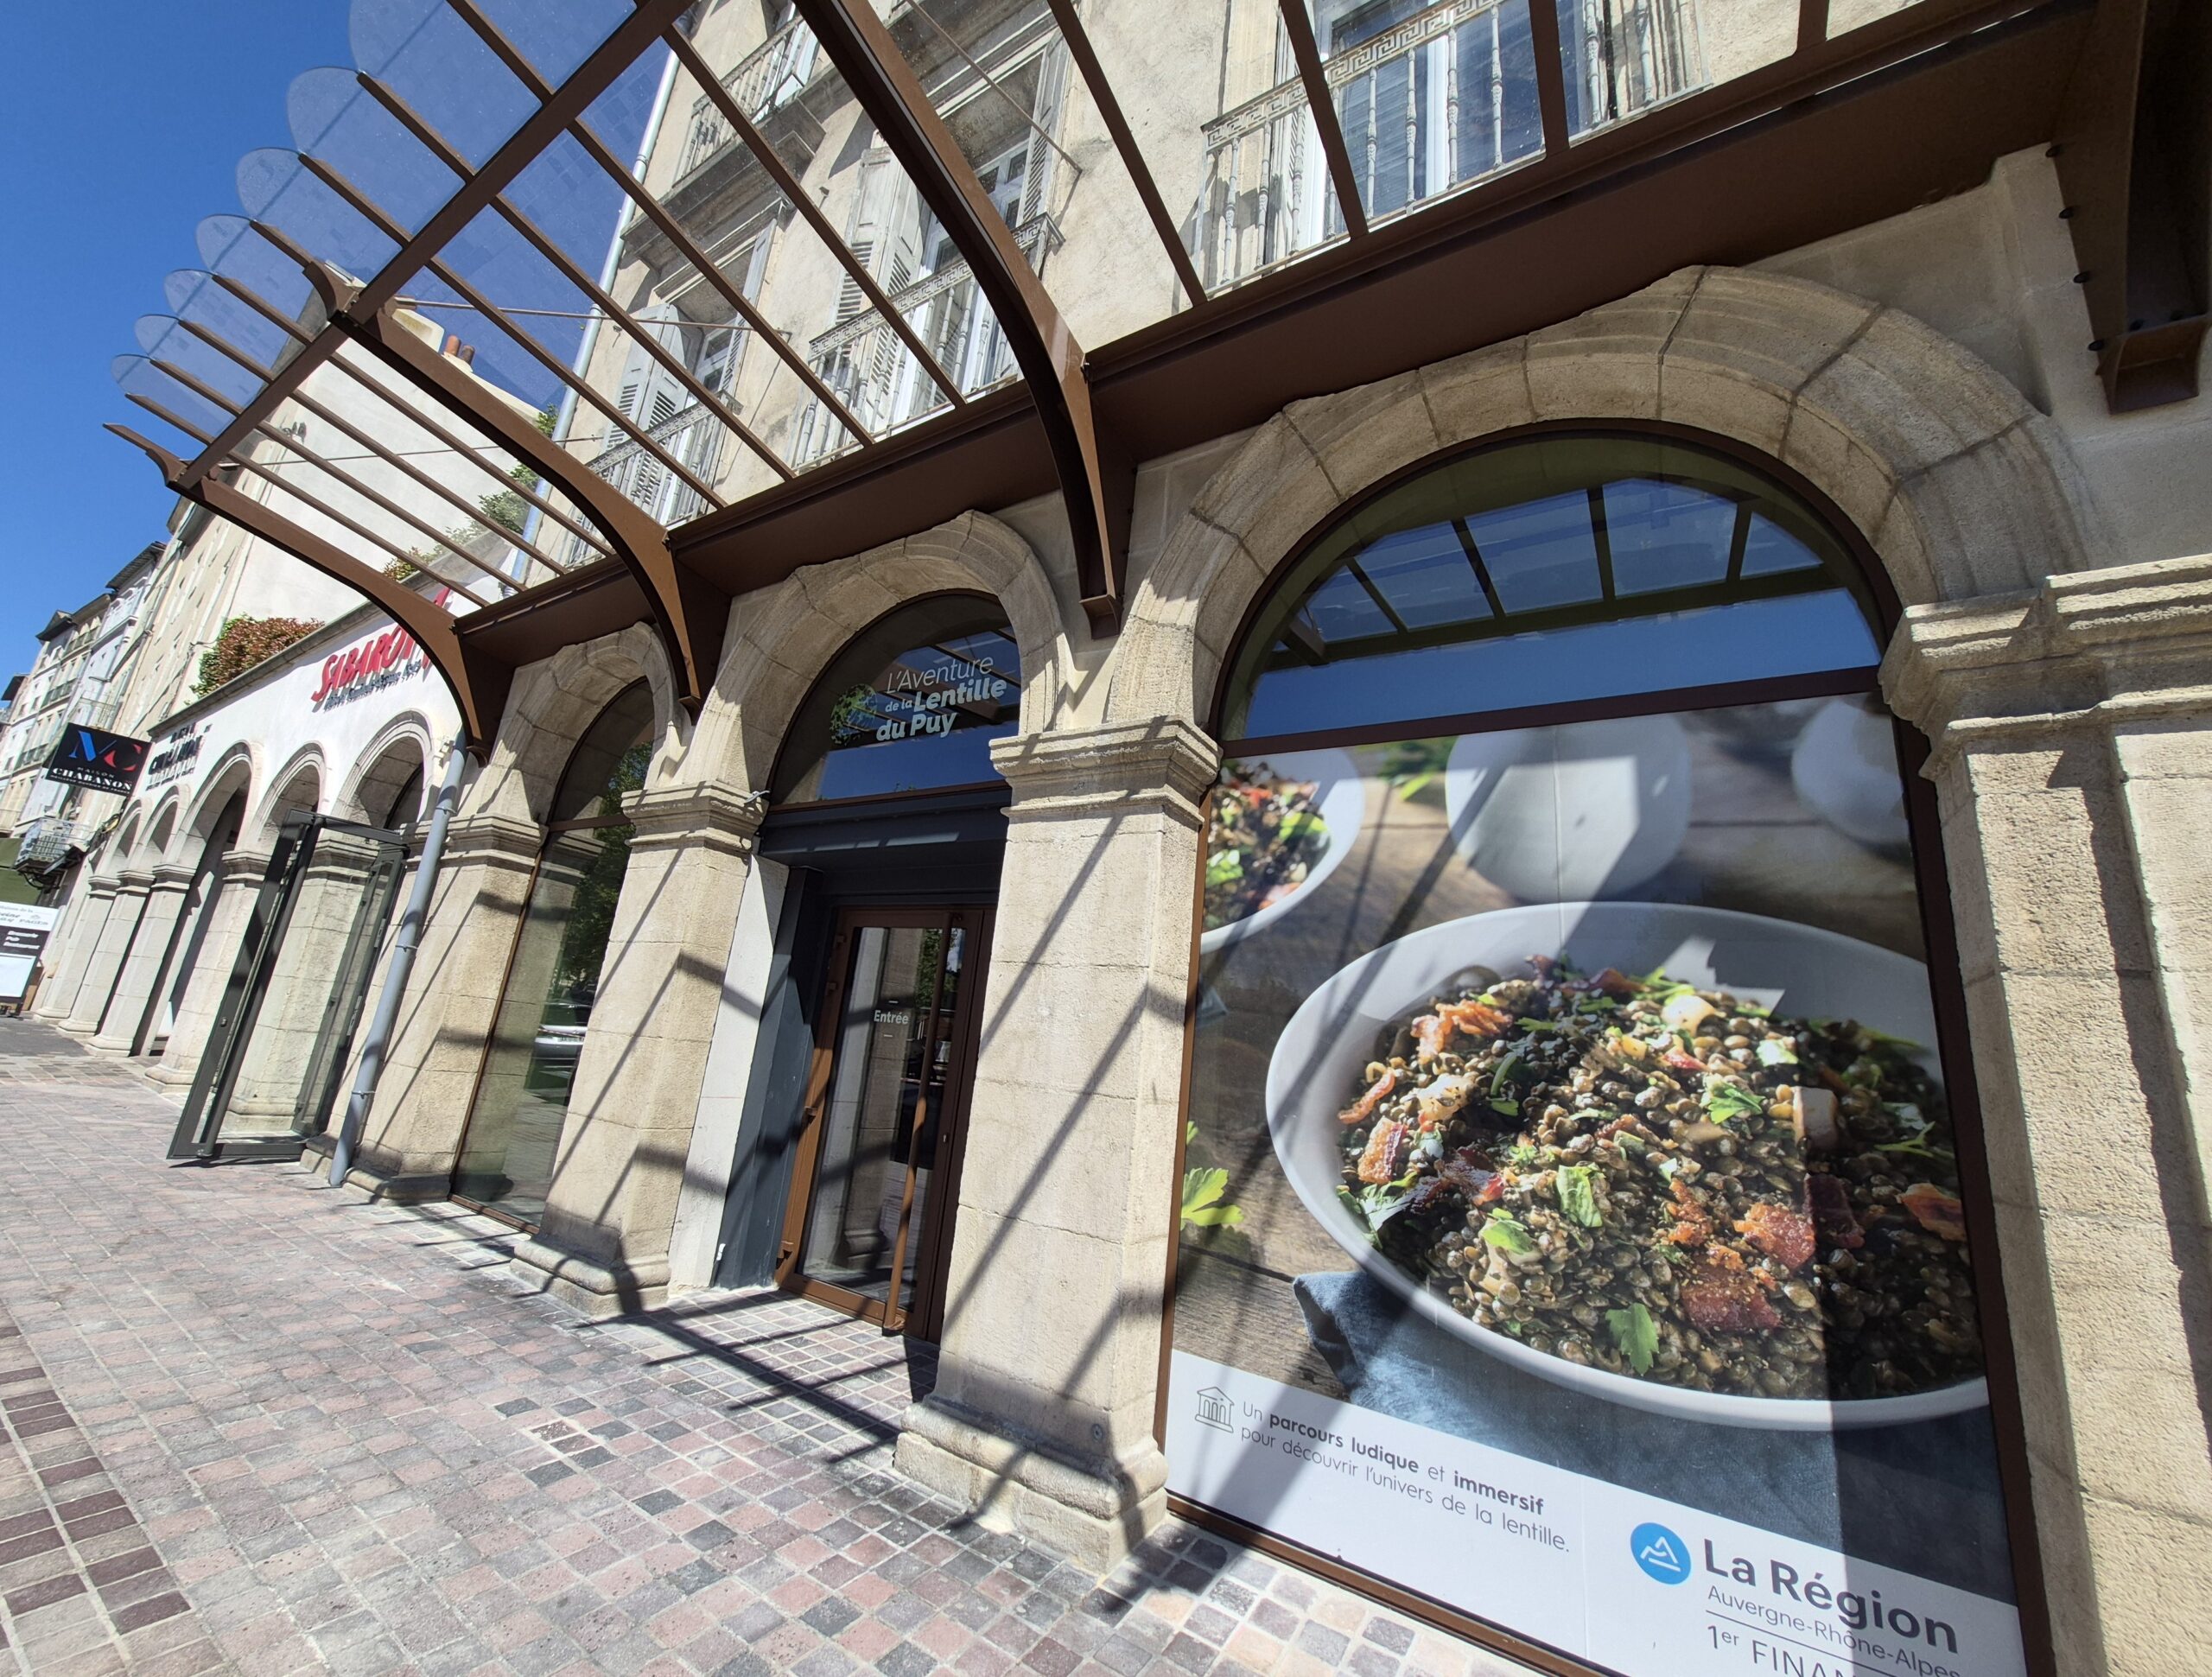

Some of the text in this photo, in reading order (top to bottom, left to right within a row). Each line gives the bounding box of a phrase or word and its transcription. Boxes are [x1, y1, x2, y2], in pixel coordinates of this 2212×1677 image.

[886, 657, 994, 694] L'Aventure
[885, 677, 1007, 713] de la Lentille
[876, 712, 958, 741] du Puy
[52, 767, 133, 791] CHABANON
[77, 766, 115, 778] MAISON
[874, 1009, 909, 1025] Entrée
[1243, 1401, 1545, 1516] Un parcours ludique et immersif
[1241, 1424, 1571, 1553] pour découvrir l'univers de la lentille.
[1703, 1538, 1960, 1655] La Région
[1707, 1624, 1739, 1650] 1er
